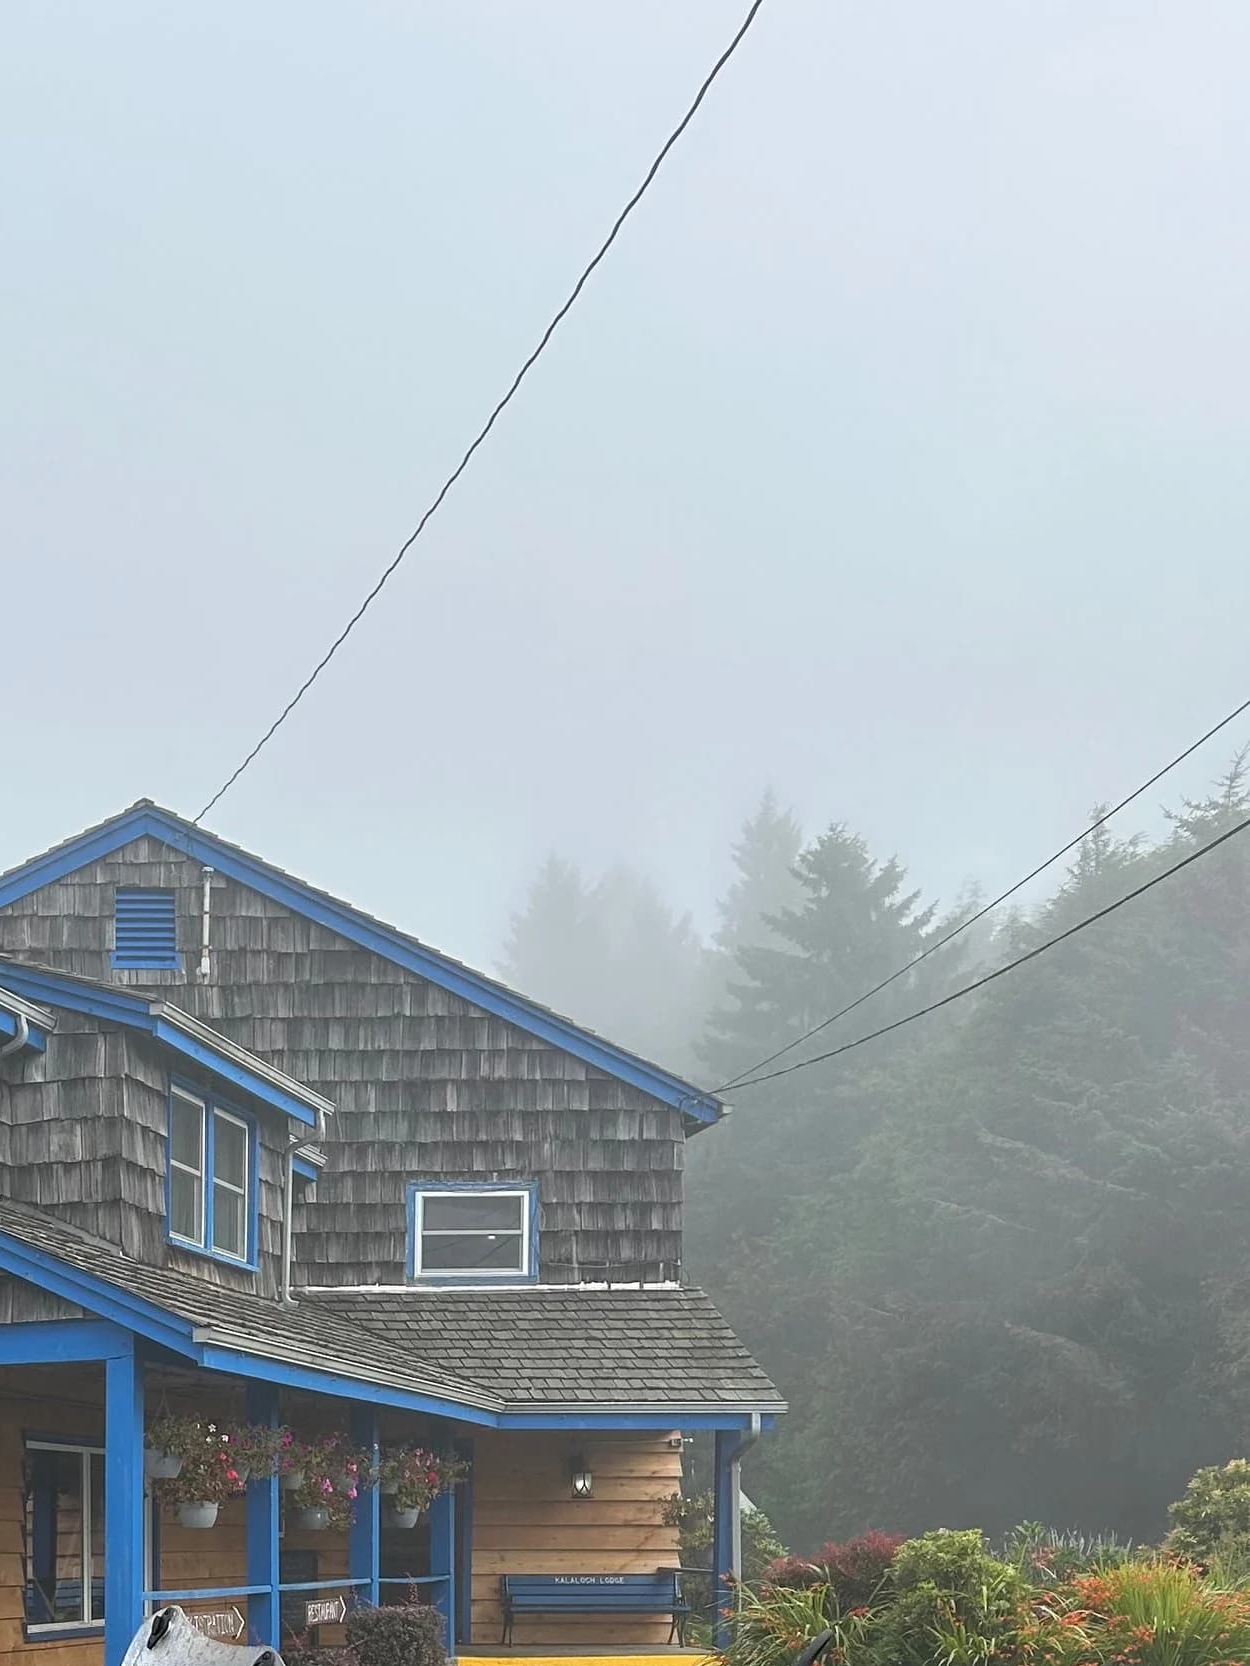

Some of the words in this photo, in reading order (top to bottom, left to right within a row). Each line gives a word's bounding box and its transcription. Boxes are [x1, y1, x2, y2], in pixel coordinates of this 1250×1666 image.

[554, 1576, 596, 1585] KALALOCH
[599, 1576, 625, 1585] LODGE
[307, 1601, 340, 1622] RESTAURANT
